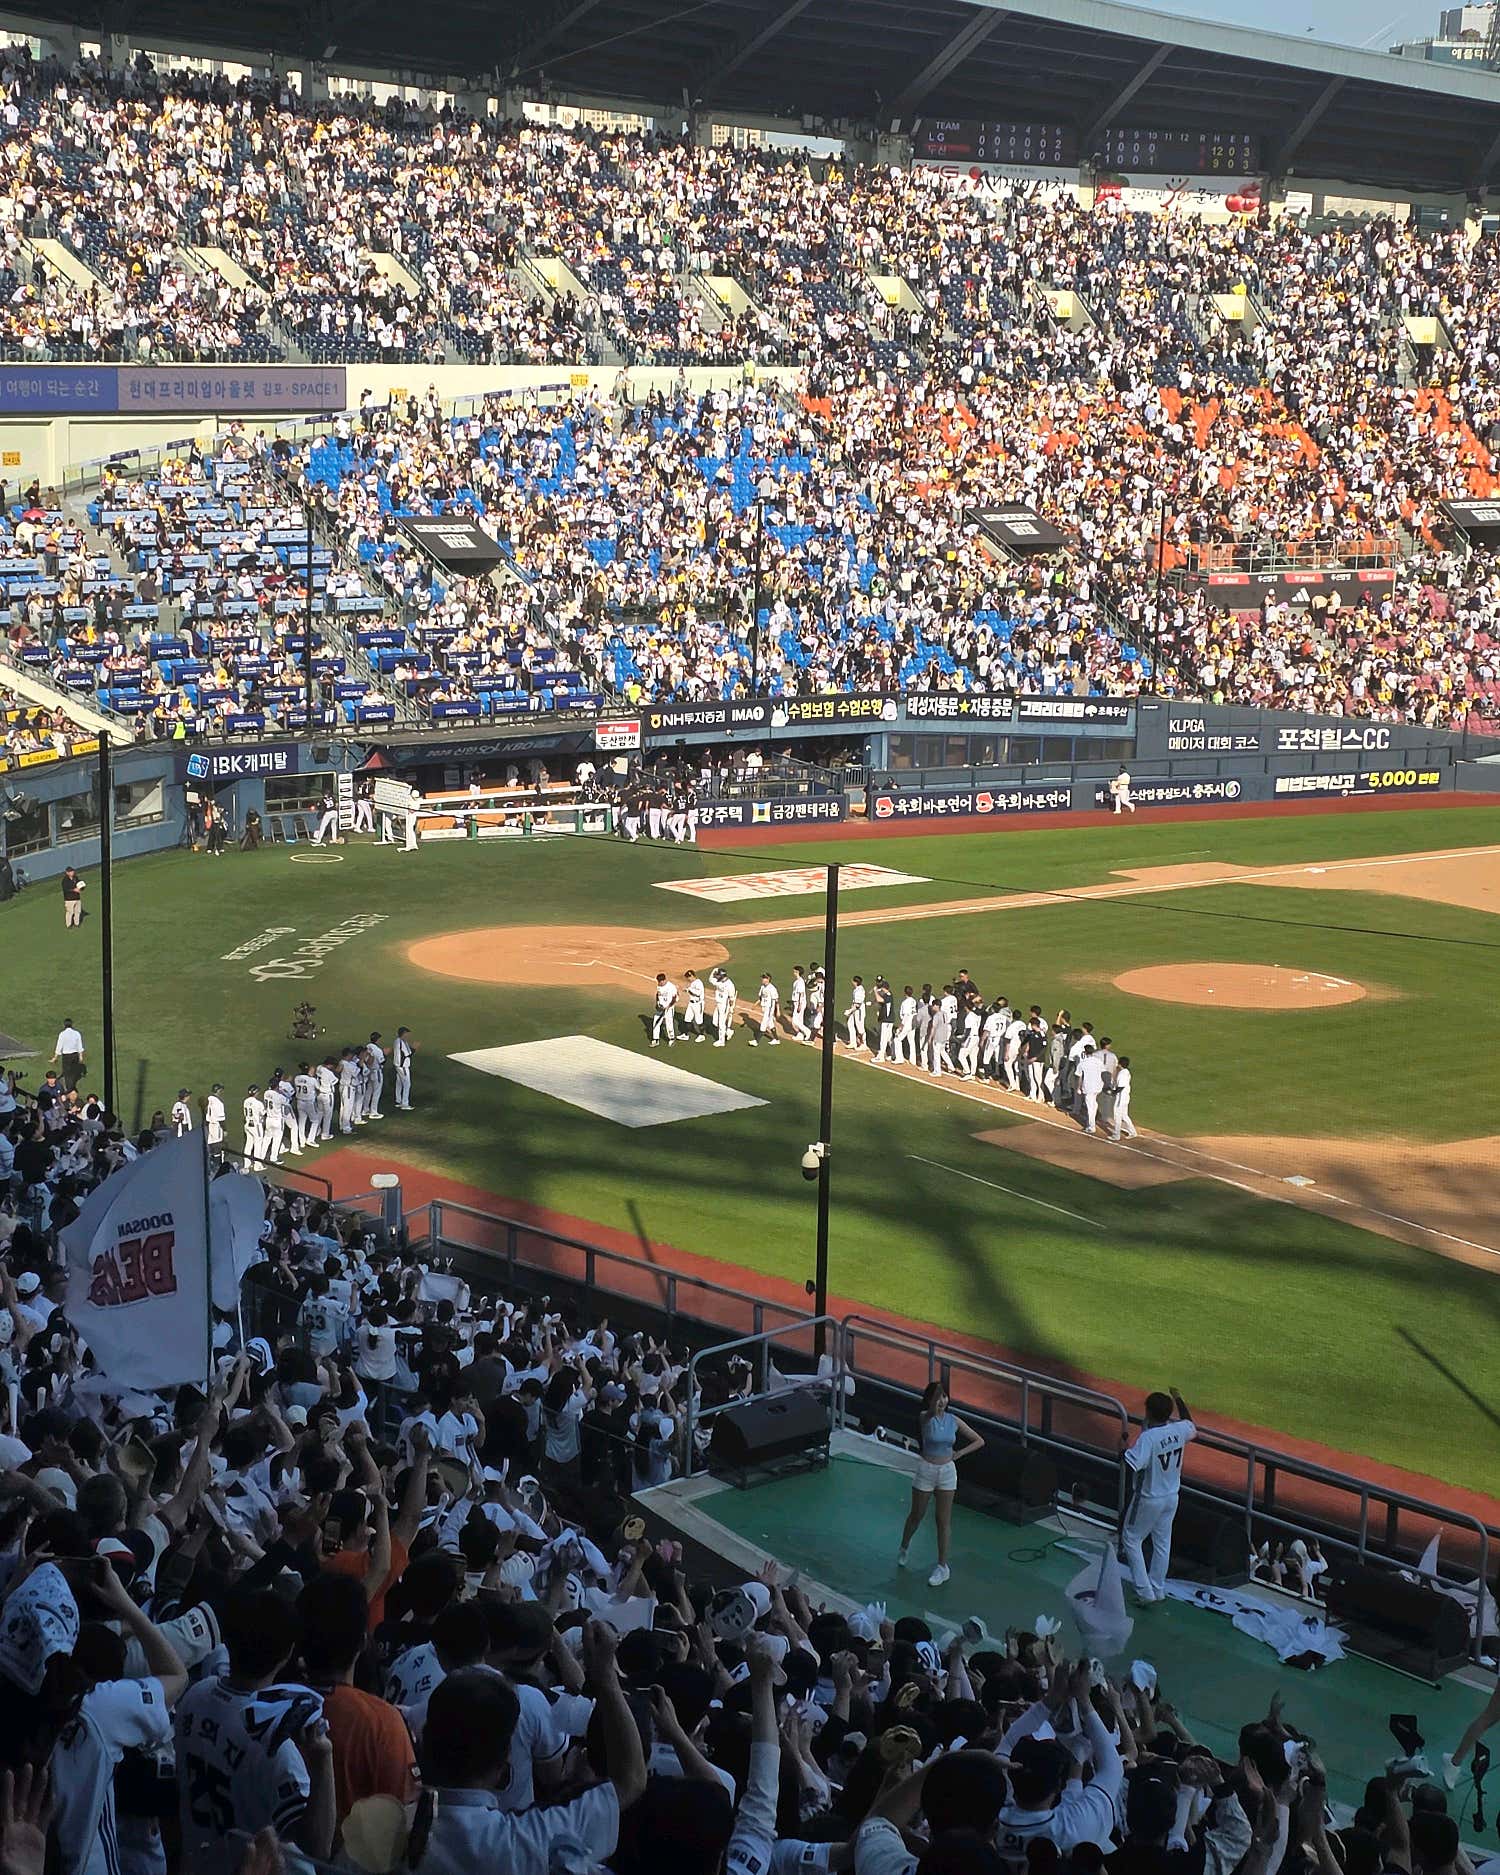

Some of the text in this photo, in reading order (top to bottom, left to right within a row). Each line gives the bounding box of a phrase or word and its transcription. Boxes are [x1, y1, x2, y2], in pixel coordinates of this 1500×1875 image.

[936, 121, 959, 131] TEAM
[979, 136, 985, 145] 0
[994, 137, 1000, 146] 0
[1010, 137, 1016, 146] 0
[1024, 138, 1030, 147] 0
[1040, 139, 1046, 148] 0
[1055, 140, 1061, 149] 2
[1118, 142, 1124, 152] 0
[1133, 143, 1139, 152] 0
[1212, 146, 1223, 156] 12
[1229, 147, 1235, 156] 0
[978, 148, 985, 157] 0
[1024, 151, 1030, 160] 0
[1039, 152, 1045, 161] 0
[1054, 152, 1061, 161] 0
[1117, 155, 1123, 164] 0
[1132, 155, 1138, 164] 0
[1227, 159, 1234, 168] 0
[6, 380, 42, 398] 여행이
[75, 380, 99, 398] 순간
[129, 379, 255, 399] 현대프리미엄아울렛
[262, 383, 283, 396] 김포
[788, 698, 883, 720] 수협보험 수협은행
[907, 697, 1012, 717] 태성자동문 자동중문
[1098, 706, 1128, 717] 초록우산
[662, 709, 726, 727] NH투자증권
[1169, 719, 1205, 733] KLPGA
[601, 735, 636, 748] 두산밥캣
[1168, 736, 1259, 750] 메이저 대회 코스
[1278, 728, 1390, 750] 포천힐스CC
[1275, 775, 1355, 793] 불법도박신고
[1368, 770, 1416, 788] 5,000
[1192, 783, 1225, 798] 충주시
[895, 794, 972, 816] 육회바른연어
[995, 789, 1071, 811] 육회바른연어
[772, 802, 840, 820] 금강펜테리움
[1158, 1447, 1183, 1472] V7
